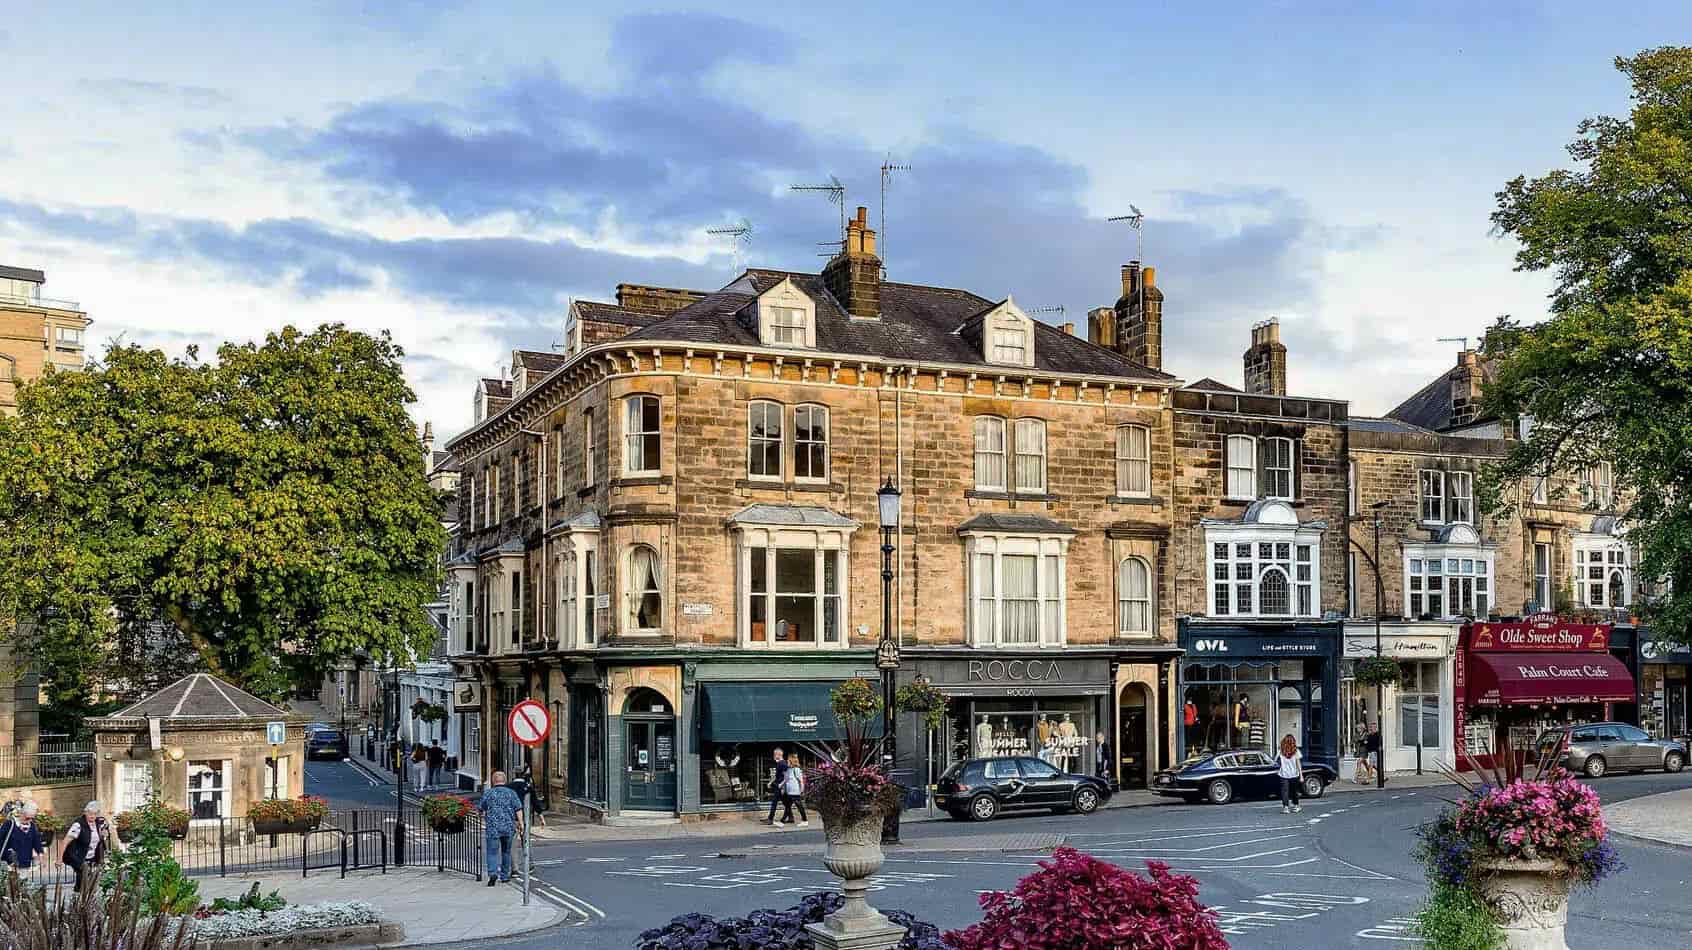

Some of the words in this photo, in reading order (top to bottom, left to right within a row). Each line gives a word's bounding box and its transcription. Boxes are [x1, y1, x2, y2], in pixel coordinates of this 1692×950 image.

[1500, 629, 1525, 644] Olde
[1527, 629, 1556, 643] Sweet
[1559, 629, 1583, 646] Shop
[1195, 639, 1228, 651] OWL
[968, 659, 1063, 681] ROCCA
[1517, 665, 1548, 678] Palm
[1550, 665, 1582, 677] Court
[1007, 688, 1034, 696] ROCCA
[1045, 737, 1088, 747] SUMMER
[1055, 747, 1080, 757] SALE
